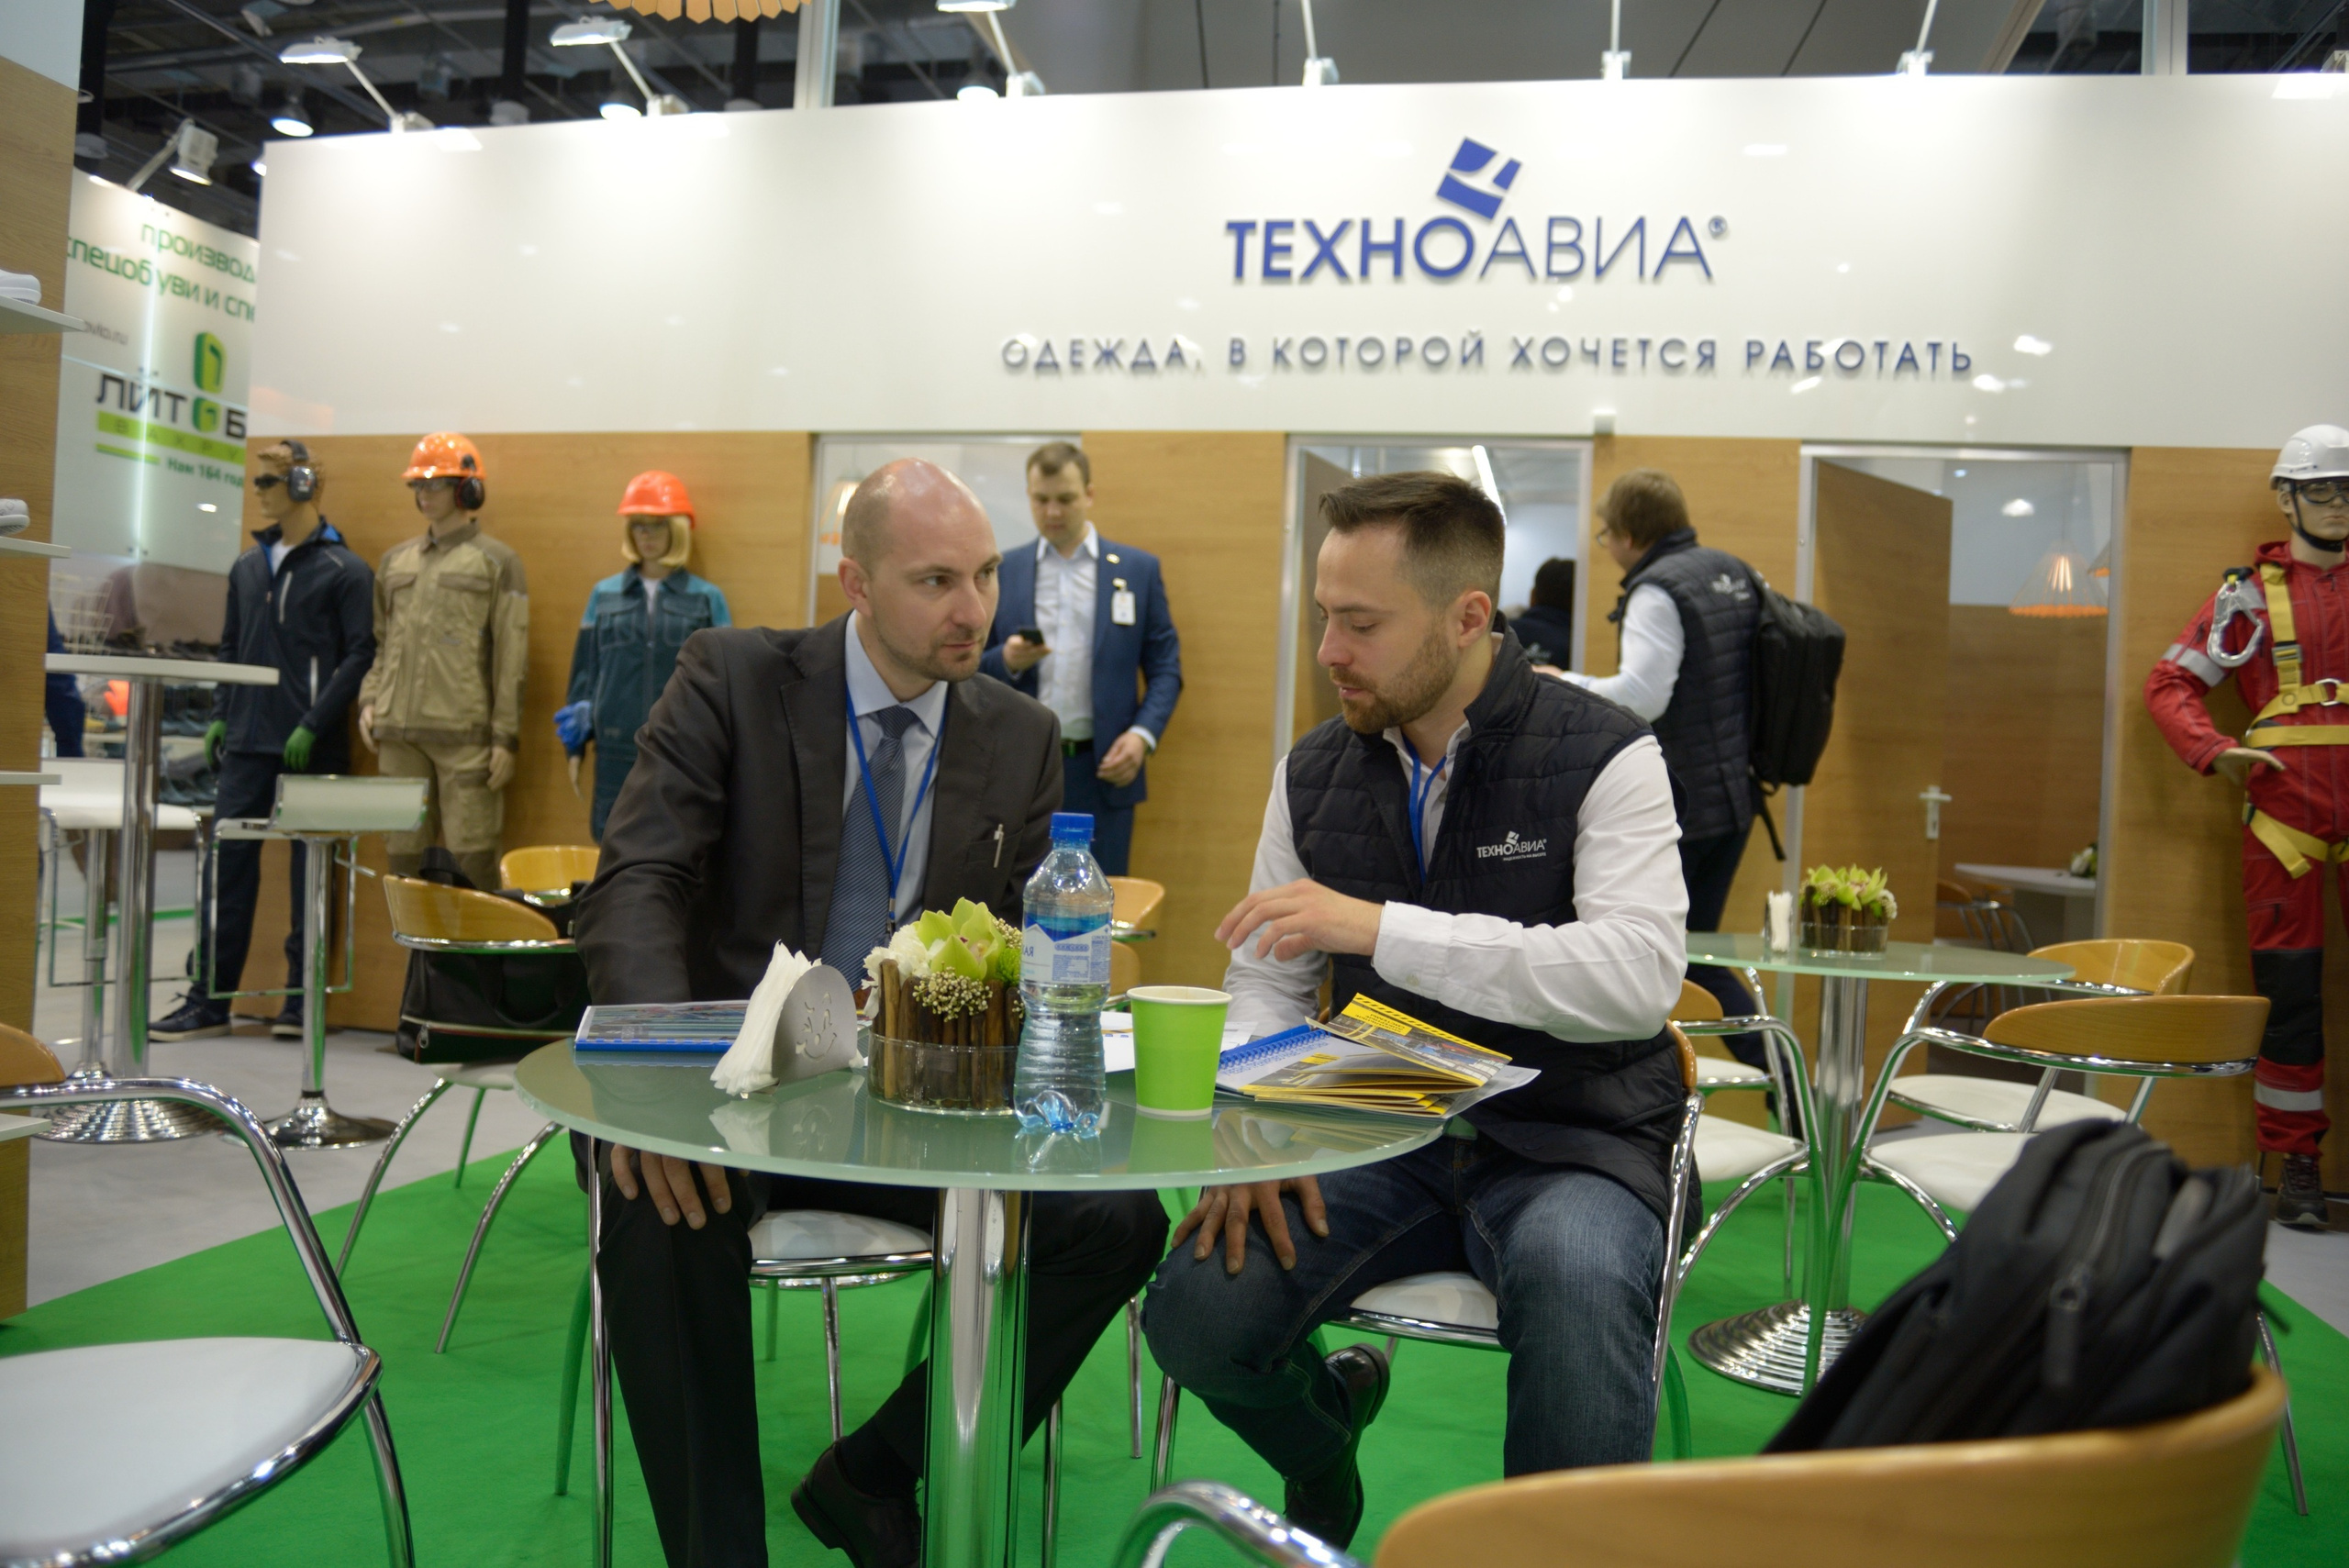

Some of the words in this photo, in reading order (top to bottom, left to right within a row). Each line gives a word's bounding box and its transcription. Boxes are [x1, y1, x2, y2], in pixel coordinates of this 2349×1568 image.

[1228, 337, 1247, 368] В
[1273, 328, 1485, 368] КОТОРОЙ
[1511, 337, 1717, 368] ХОЧЕТСЯ
[1746, 339, 1972, 373] РАБОТАТЬ
